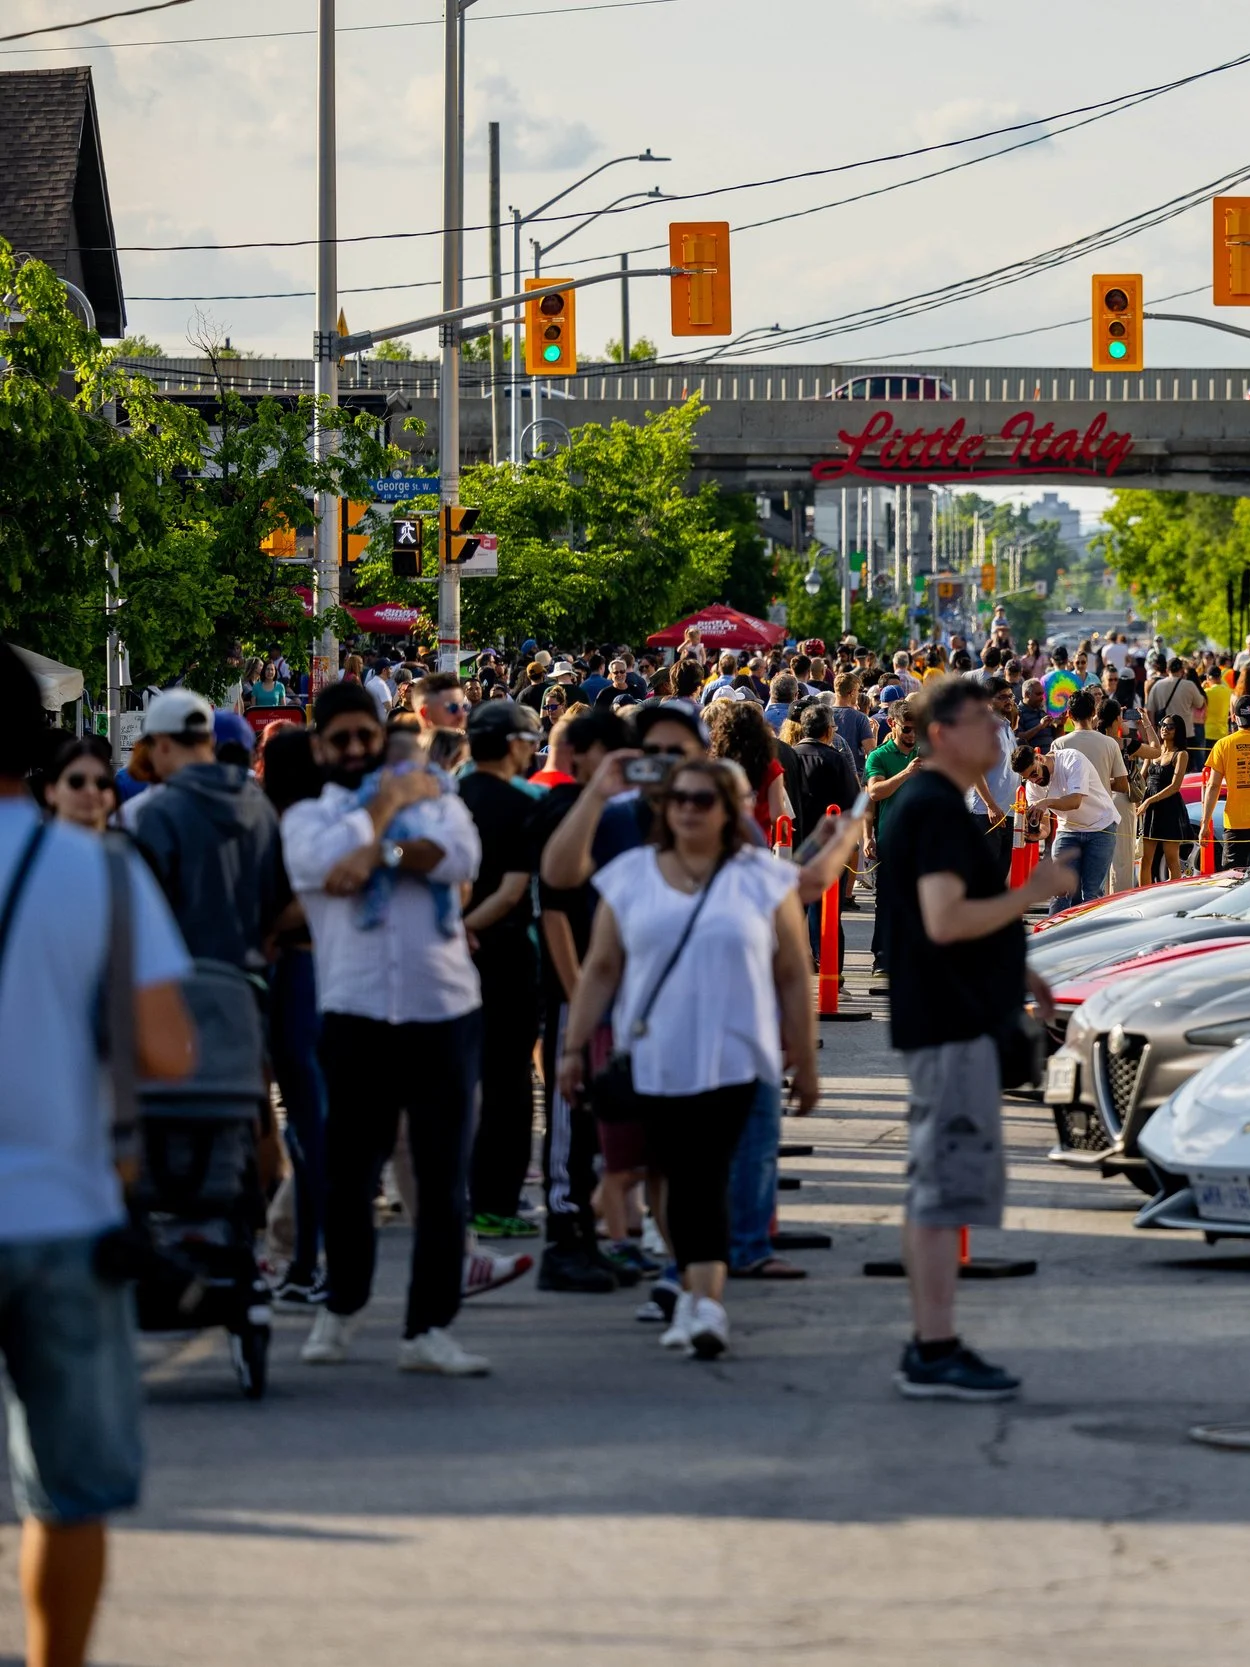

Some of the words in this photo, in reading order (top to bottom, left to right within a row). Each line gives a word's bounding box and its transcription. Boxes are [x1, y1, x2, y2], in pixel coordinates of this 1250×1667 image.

[811, 411, 986, 482] Little
[1001, 411, 1134, 478] Italy
[376, 480, 410, 494] George
[412, 483, 420, 491] St.
